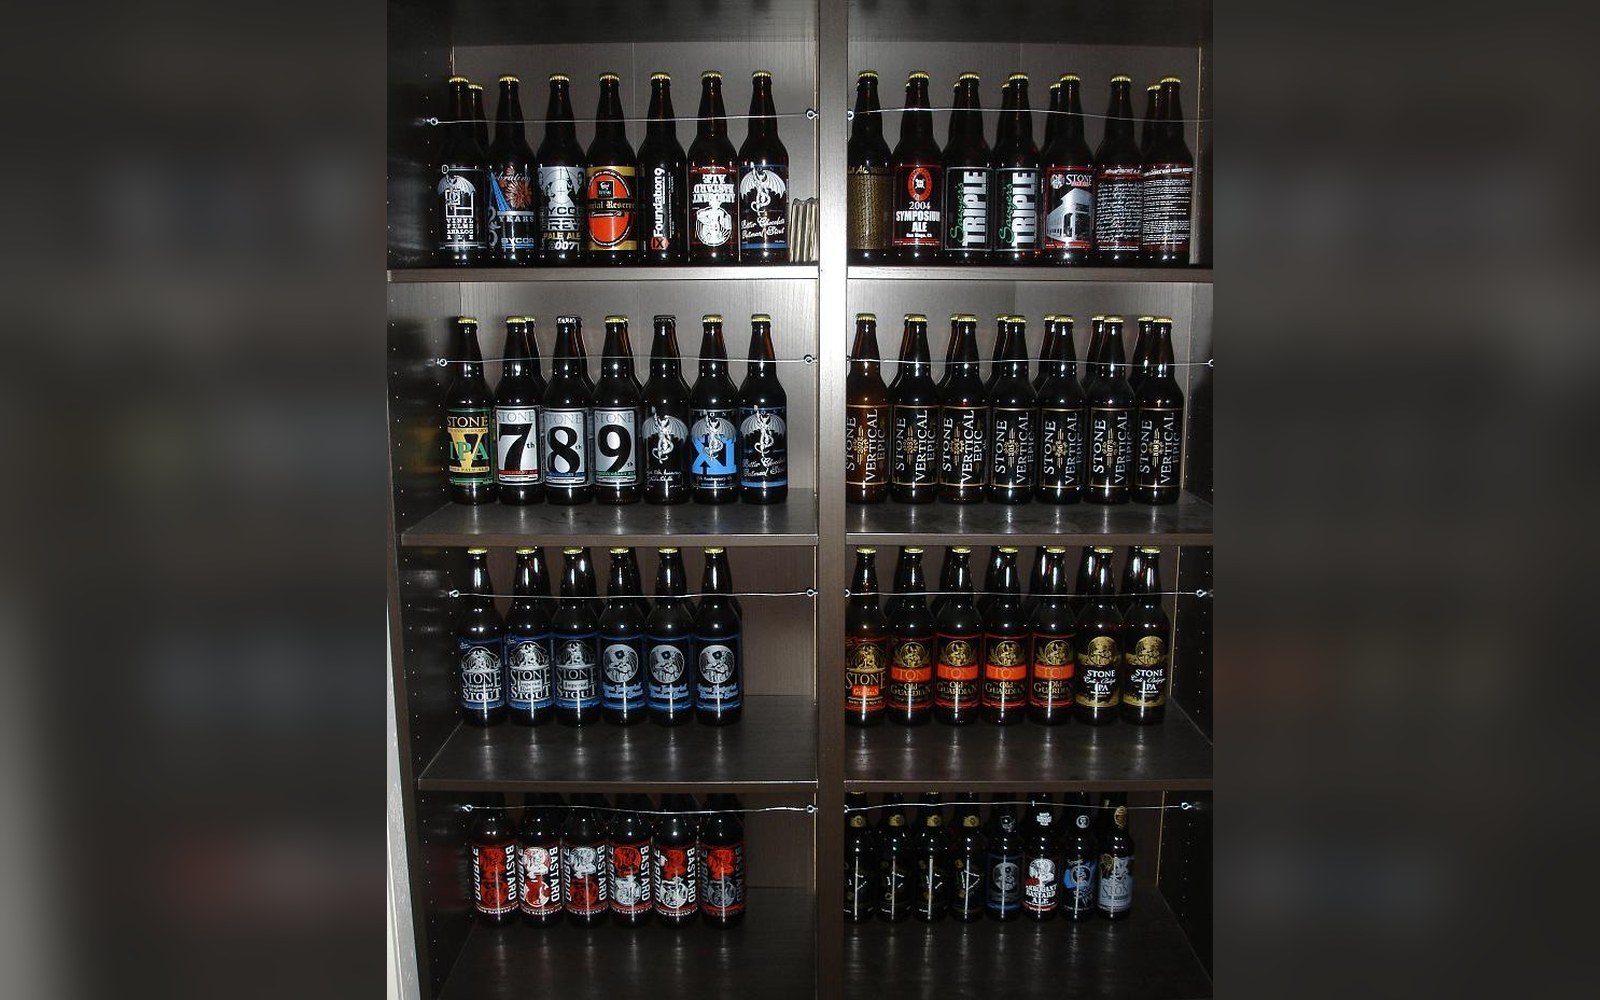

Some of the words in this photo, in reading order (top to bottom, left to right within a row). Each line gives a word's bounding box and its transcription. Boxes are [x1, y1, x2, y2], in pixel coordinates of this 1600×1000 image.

[702, 174, 727, 184] ALE
[1066, 174, 1092, 186] STONE
[909, 201, 931, 210] 2004
[911, 222, 927, 232] ALE
[962, 172, 986, 247] TRIPLE
[1011, 172, 1035, 247] TRIPLE
[543, 232, 564, 240] PALE
[566, 232, 581, 240] ALE
[548, 241, 575, 250] 2007
[447, 416, 488, 427] STONE
[497, 412, 535, 421] STONE
[449, 441, 489, 461] IPA
[846, 418, 856, 471] STONE
[865, 409, 878, 481] VERTICAL
[877, 430, 885, 460] EPIC
[896, 418, 906, 471] STONE
[915, 410, 928, 481] VERTICAL
[927, 430, 935, 460] EPIC
[943, 418, 953, 471] STONE
[961, 410, 974, 481] VERTICAL
[974, 430, 983, 461] EPIC
[995, 420, 1007, 474] STONE
[1017, 412, 1029, 484] VERTICAL
[1044, 421, 1056, 475] STONE
[1065, 413, 1077, 485] VERTICAL
[1093, 420, 1106, 474] STONE
[1115, 411, 1128, 483] VERTICAL
[1140, 420, 1152, 473] STONE
[1161, 412, 1174, 484] VERTICAL
[462, 671, 501, 688] STONE
[463, 688, 502, 700] STOUT
[510, 669, 550, 685] STONE
[511, 684, 551, 698] STOUT
[557, 683, 597, 698] STOUT
[846, 671, 886, 689] STONE
[1087, 670, 1115, 678] STONE
[1135, 669, 1163, 677] STONE
[473, 848, 481, 900] DOUBLE
[505, 844, 517, 900] BASTARD
[549, 846, 560, 902] BASTARD
[597, 845, 607, 900] BASTARD
[641, 846, 651, 901] BASTARD
[687, 848, 696, 903] BASTARD
